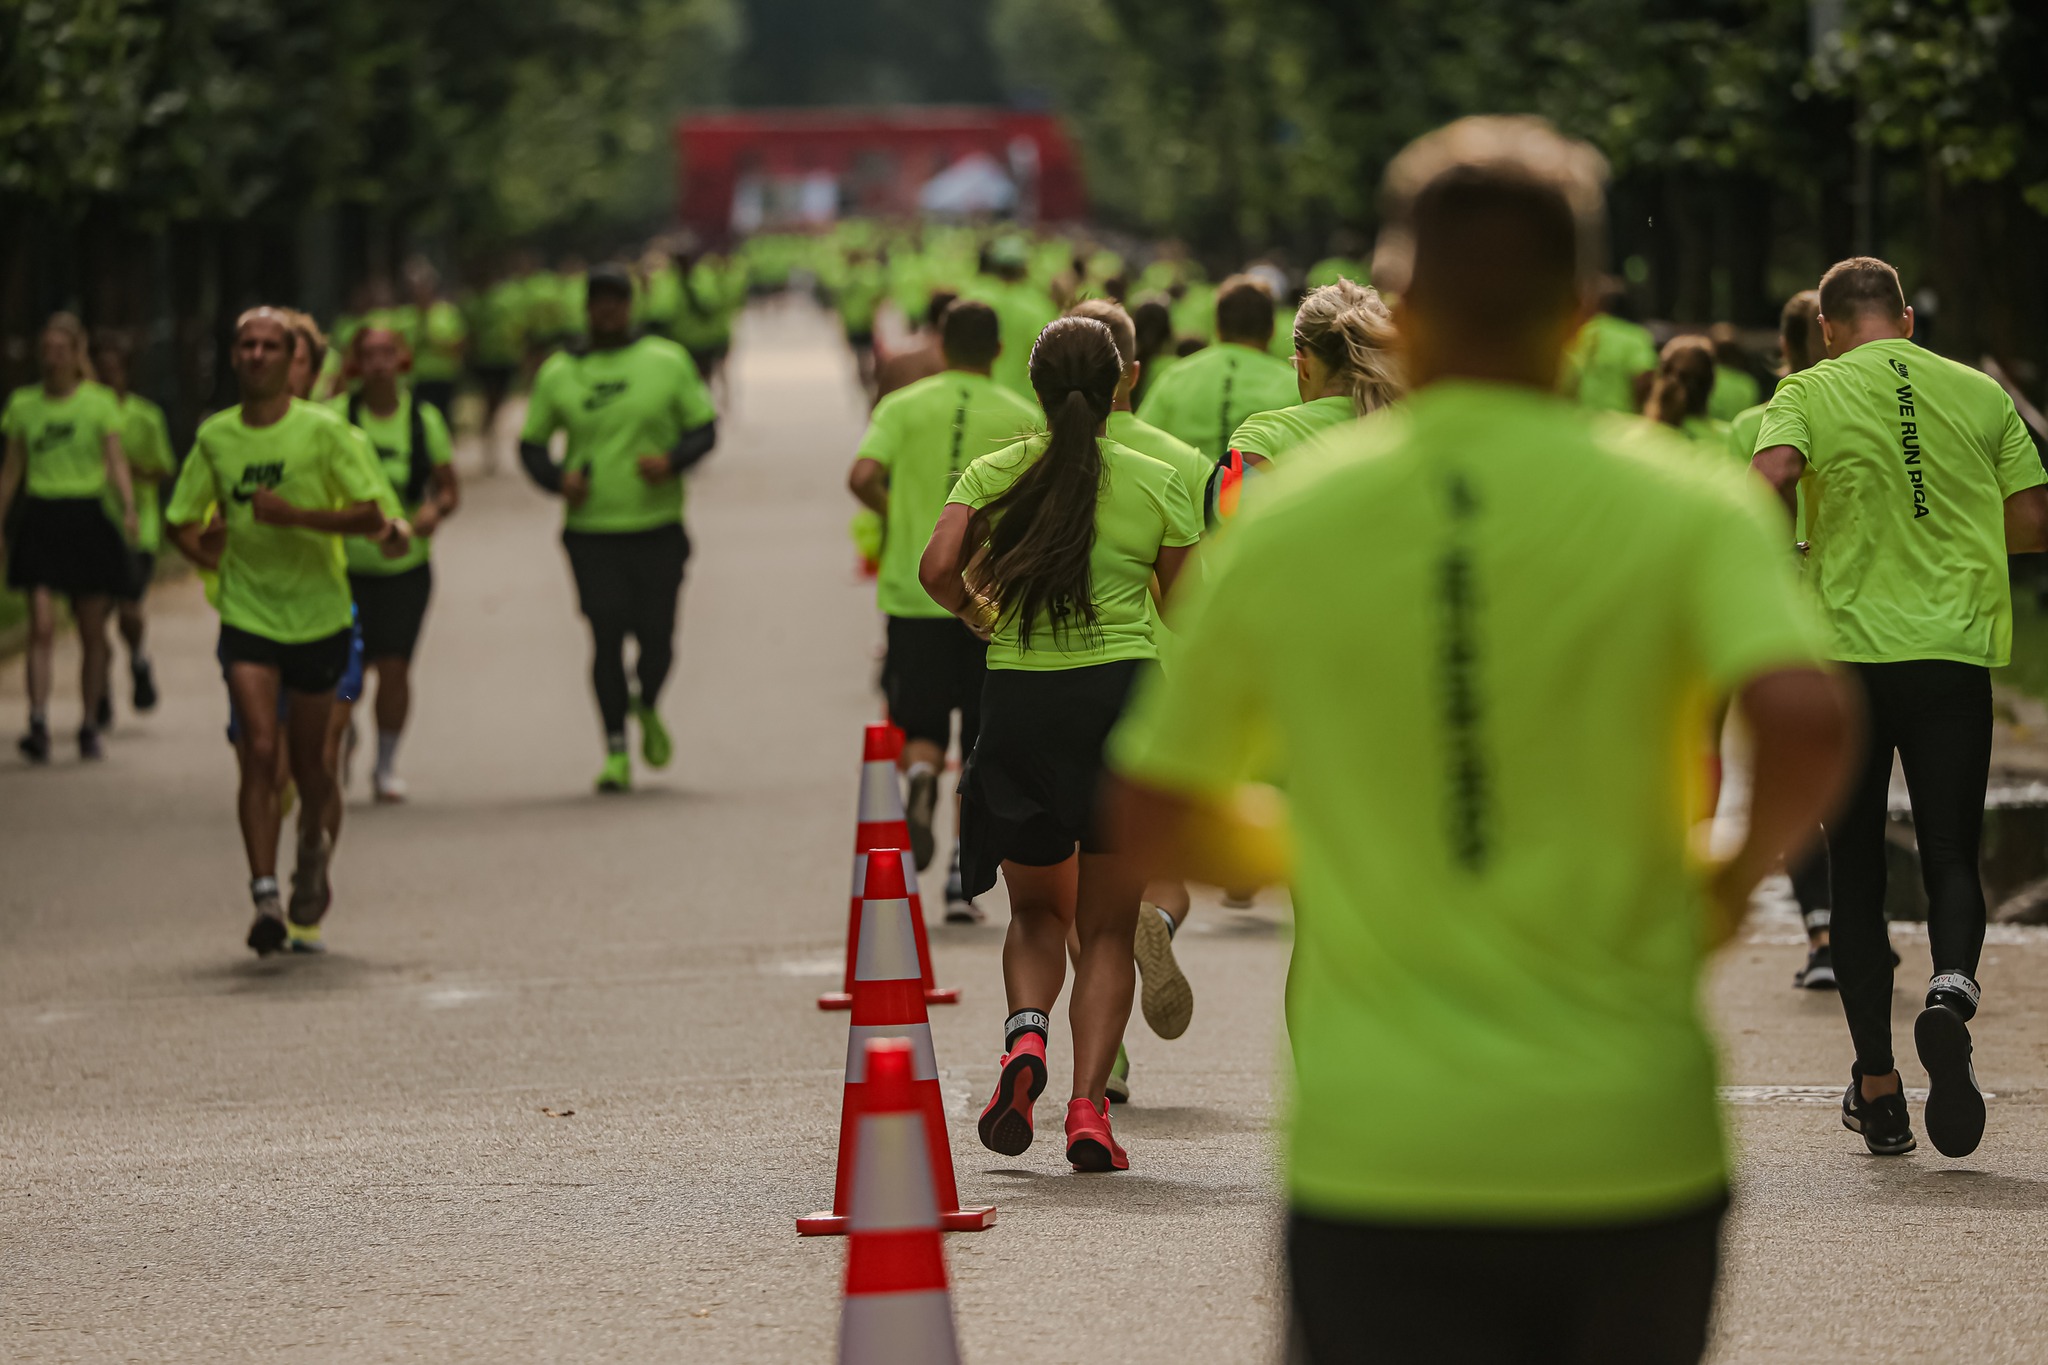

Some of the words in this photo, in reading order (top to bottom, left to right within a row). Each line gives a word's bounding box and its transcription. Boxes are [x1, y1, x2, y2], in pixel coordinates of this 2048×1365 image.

[1897, 362, 1909, 380] RUN
[1896, 384, 1915, 417] WE
[1901, 421, 1921, 465] RUN
[1907, 470, 1930, 519] RIGA
[1031, 1013, 1049, 1030] 03
